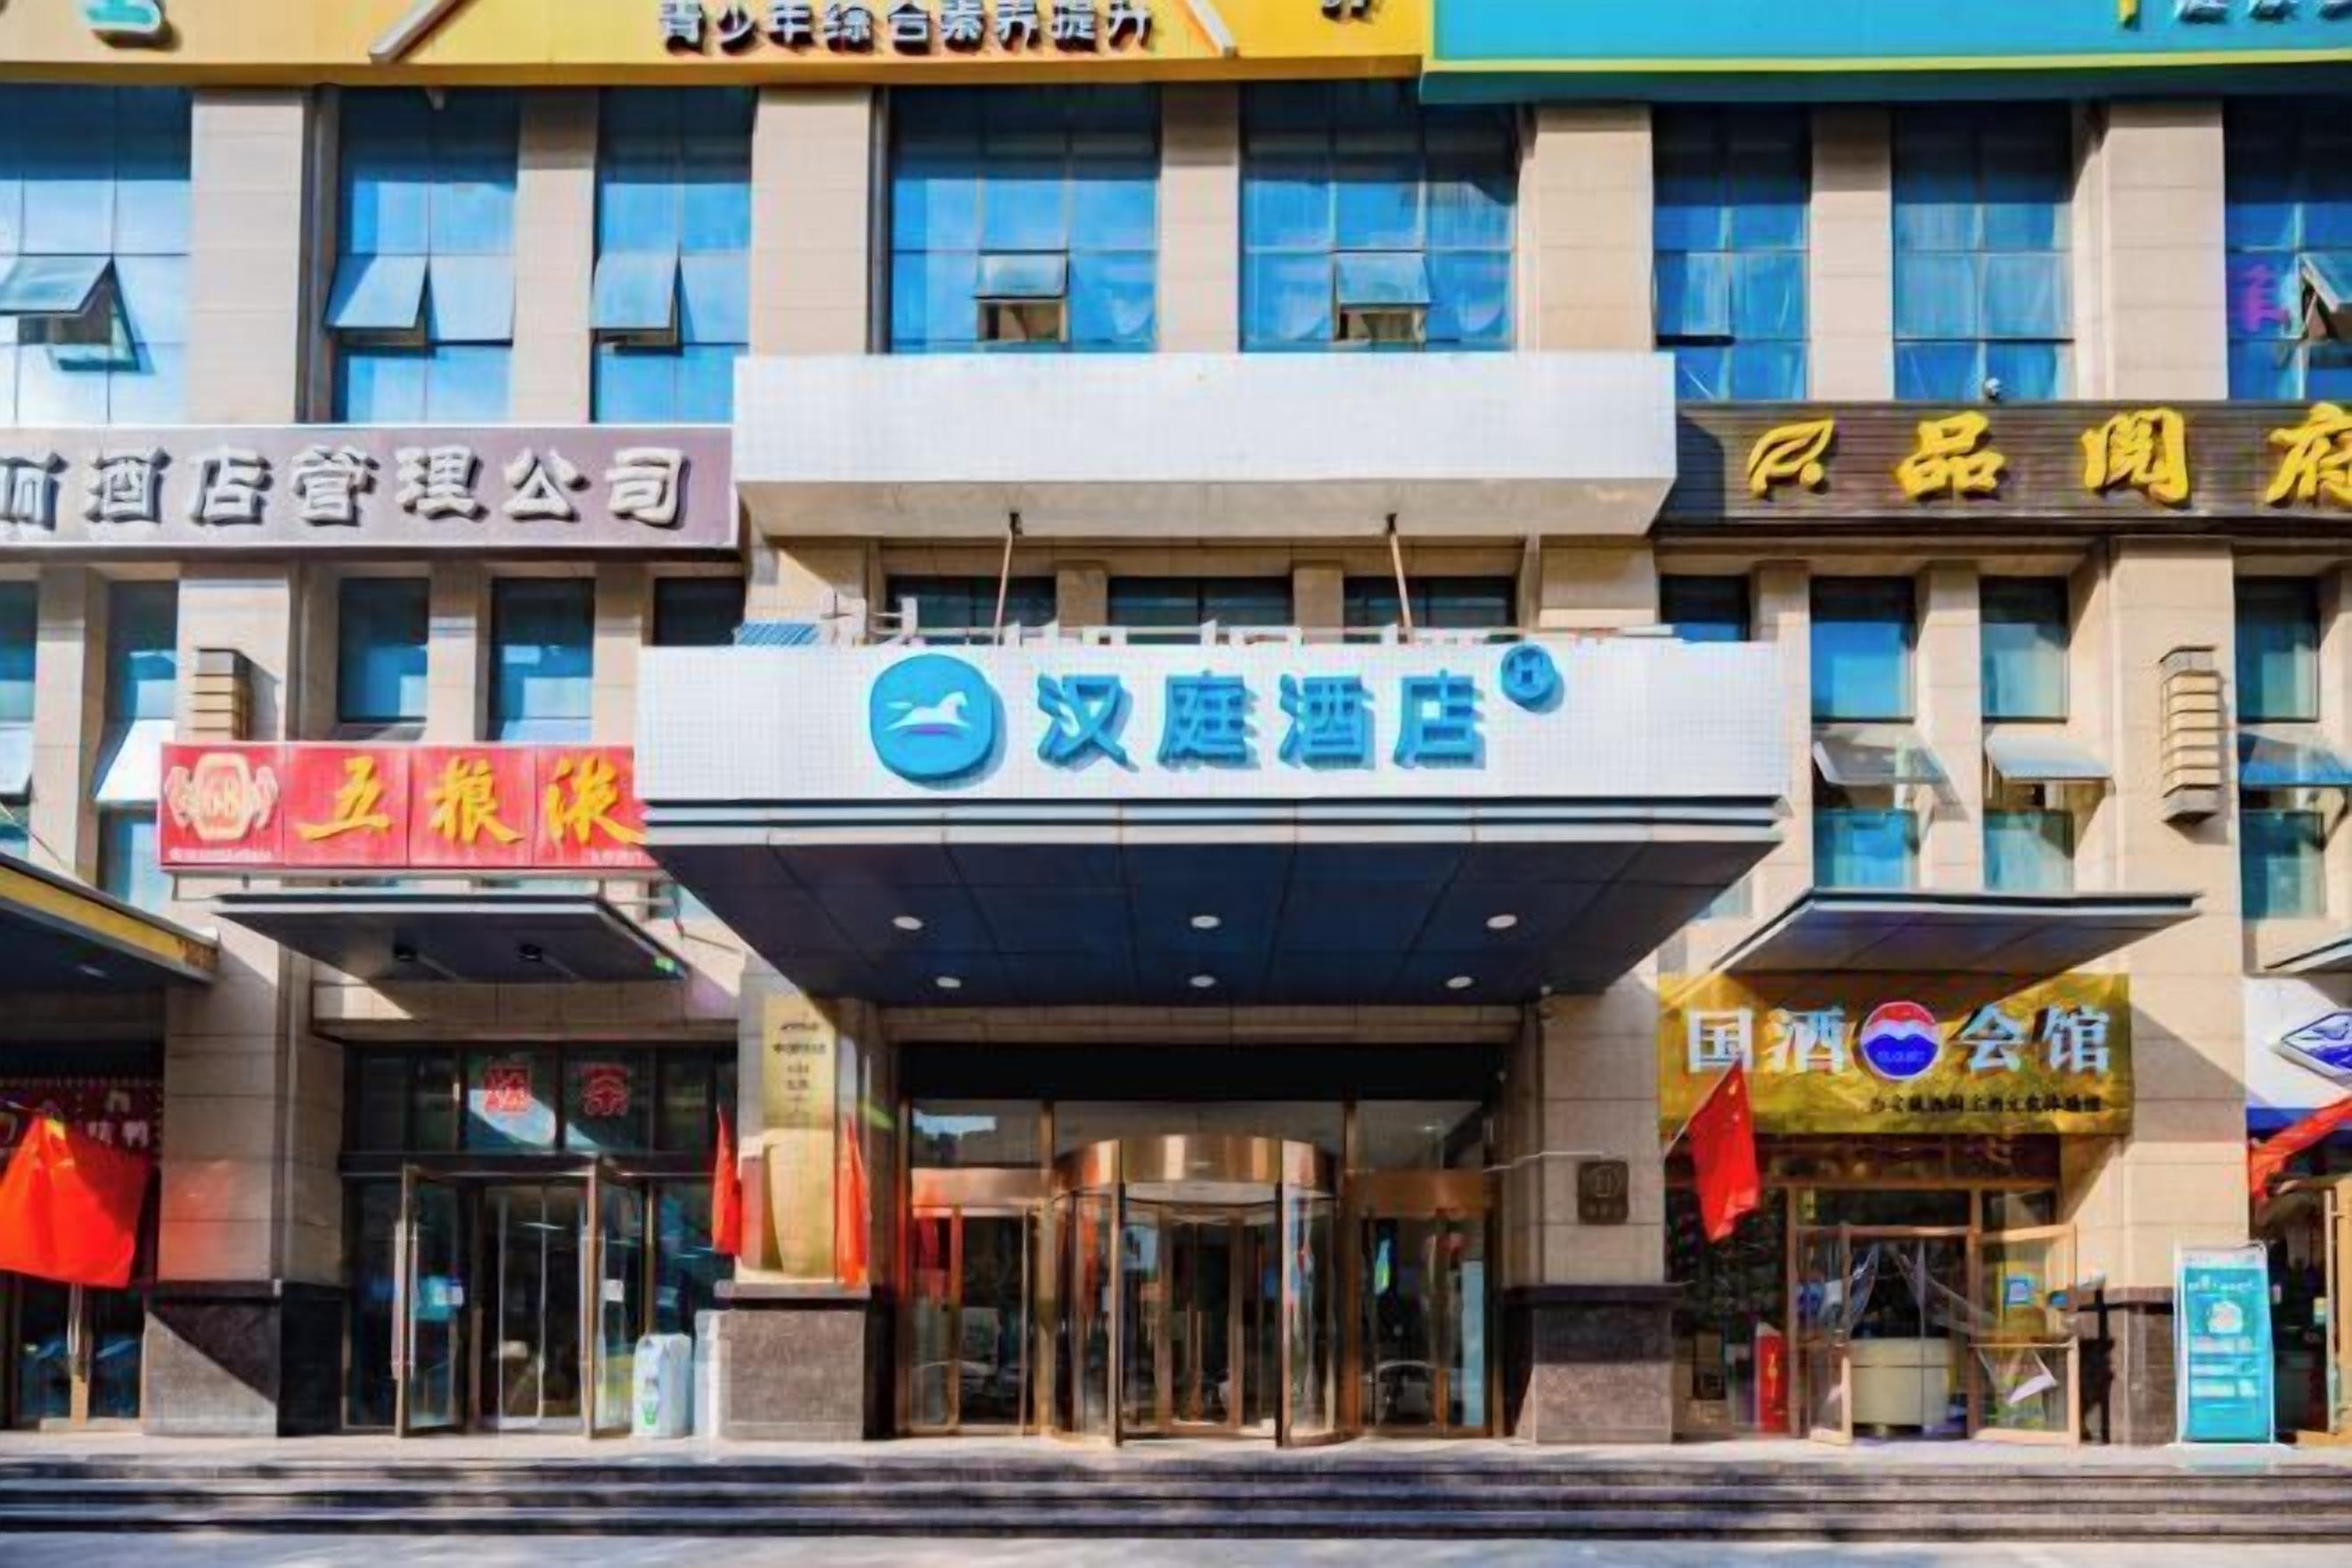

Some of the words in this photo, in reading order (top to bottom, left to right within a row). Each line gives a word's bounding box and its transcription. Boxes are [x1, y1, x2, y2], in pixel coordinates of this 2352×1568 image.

[660, 0, 1153, 46] 青少年综合素养提升
[1038, 669, 1479, 768] 汉庭酒店
[292, 754, 648, 844] 五粮液
[1686, 1007, 1844, 1074] 国酒
[1960, 1001, 2111, 1074] 会馆
